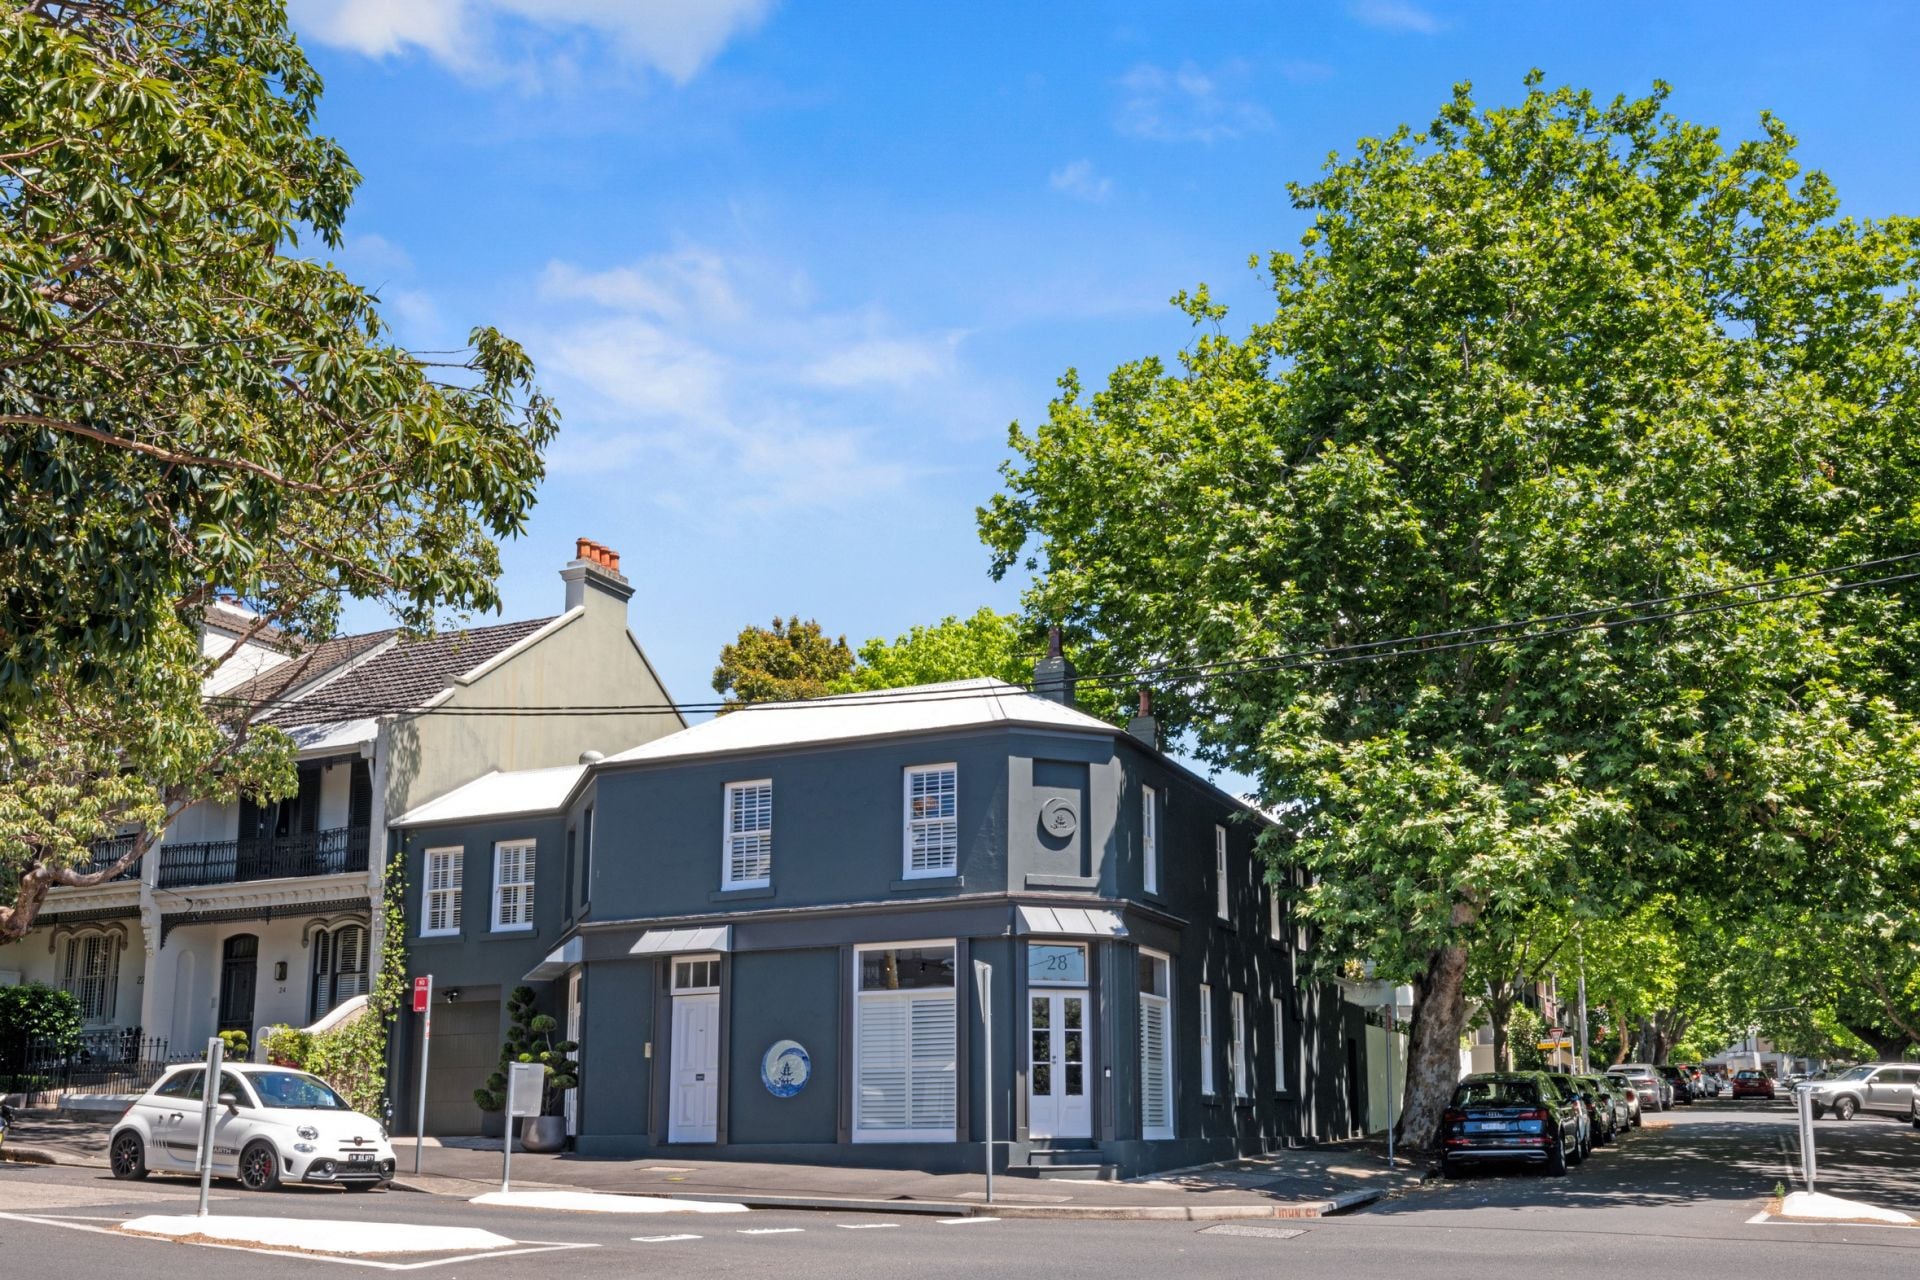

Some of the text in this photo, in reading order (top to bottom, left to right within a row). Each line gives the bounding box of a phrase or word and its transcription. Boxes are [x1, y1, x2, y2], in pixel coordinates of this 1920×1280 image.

[1047, 955, 1067, 970] 28
[137, 976, 145, 984] 22
[278, 986, 287, 994] 24
